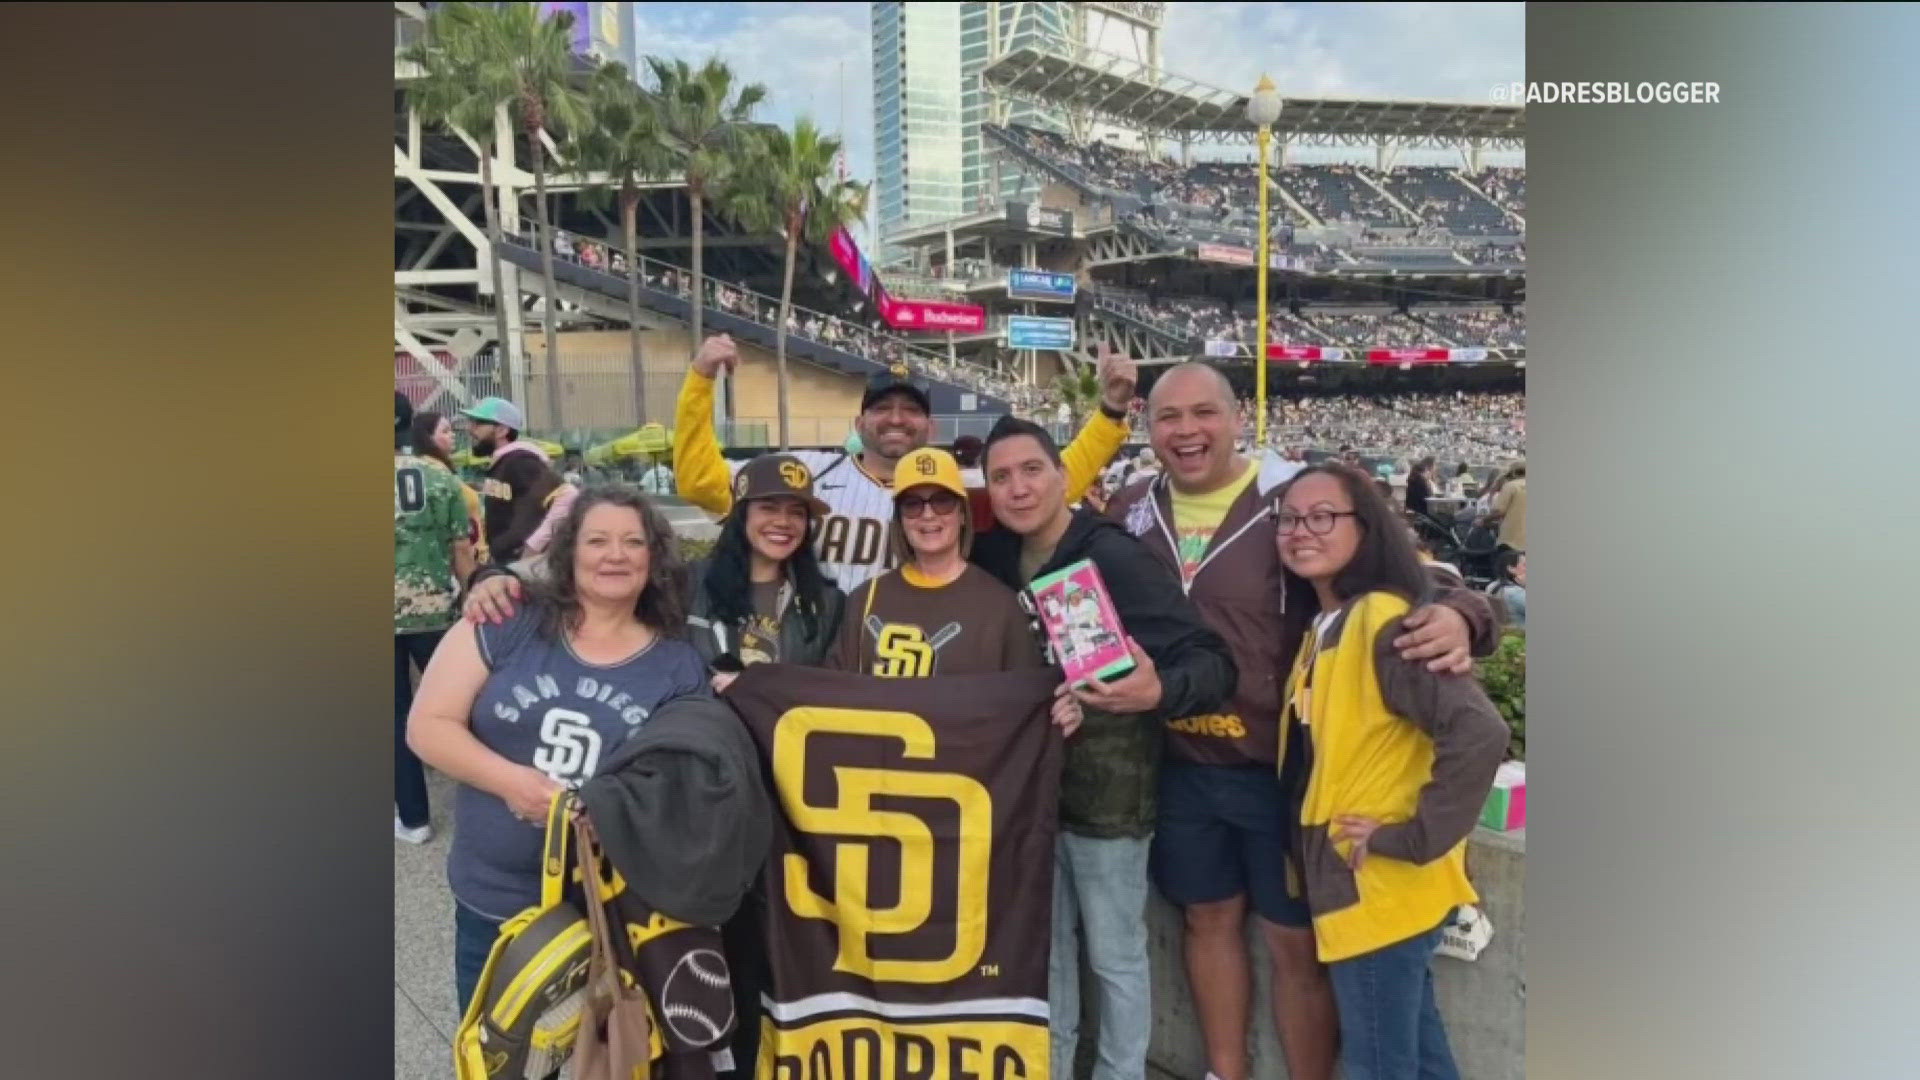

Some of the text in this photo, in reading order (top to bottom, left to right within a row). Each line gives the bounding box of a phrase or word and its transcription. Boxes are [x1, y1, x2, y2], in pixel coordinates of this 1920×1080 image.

[494, 673, 649, 739] SAN DIEG
[772, 705, 993, 984] SD
[980, 965, 999, 977] TM
[773, 1027, 1027, 1080] DRE
